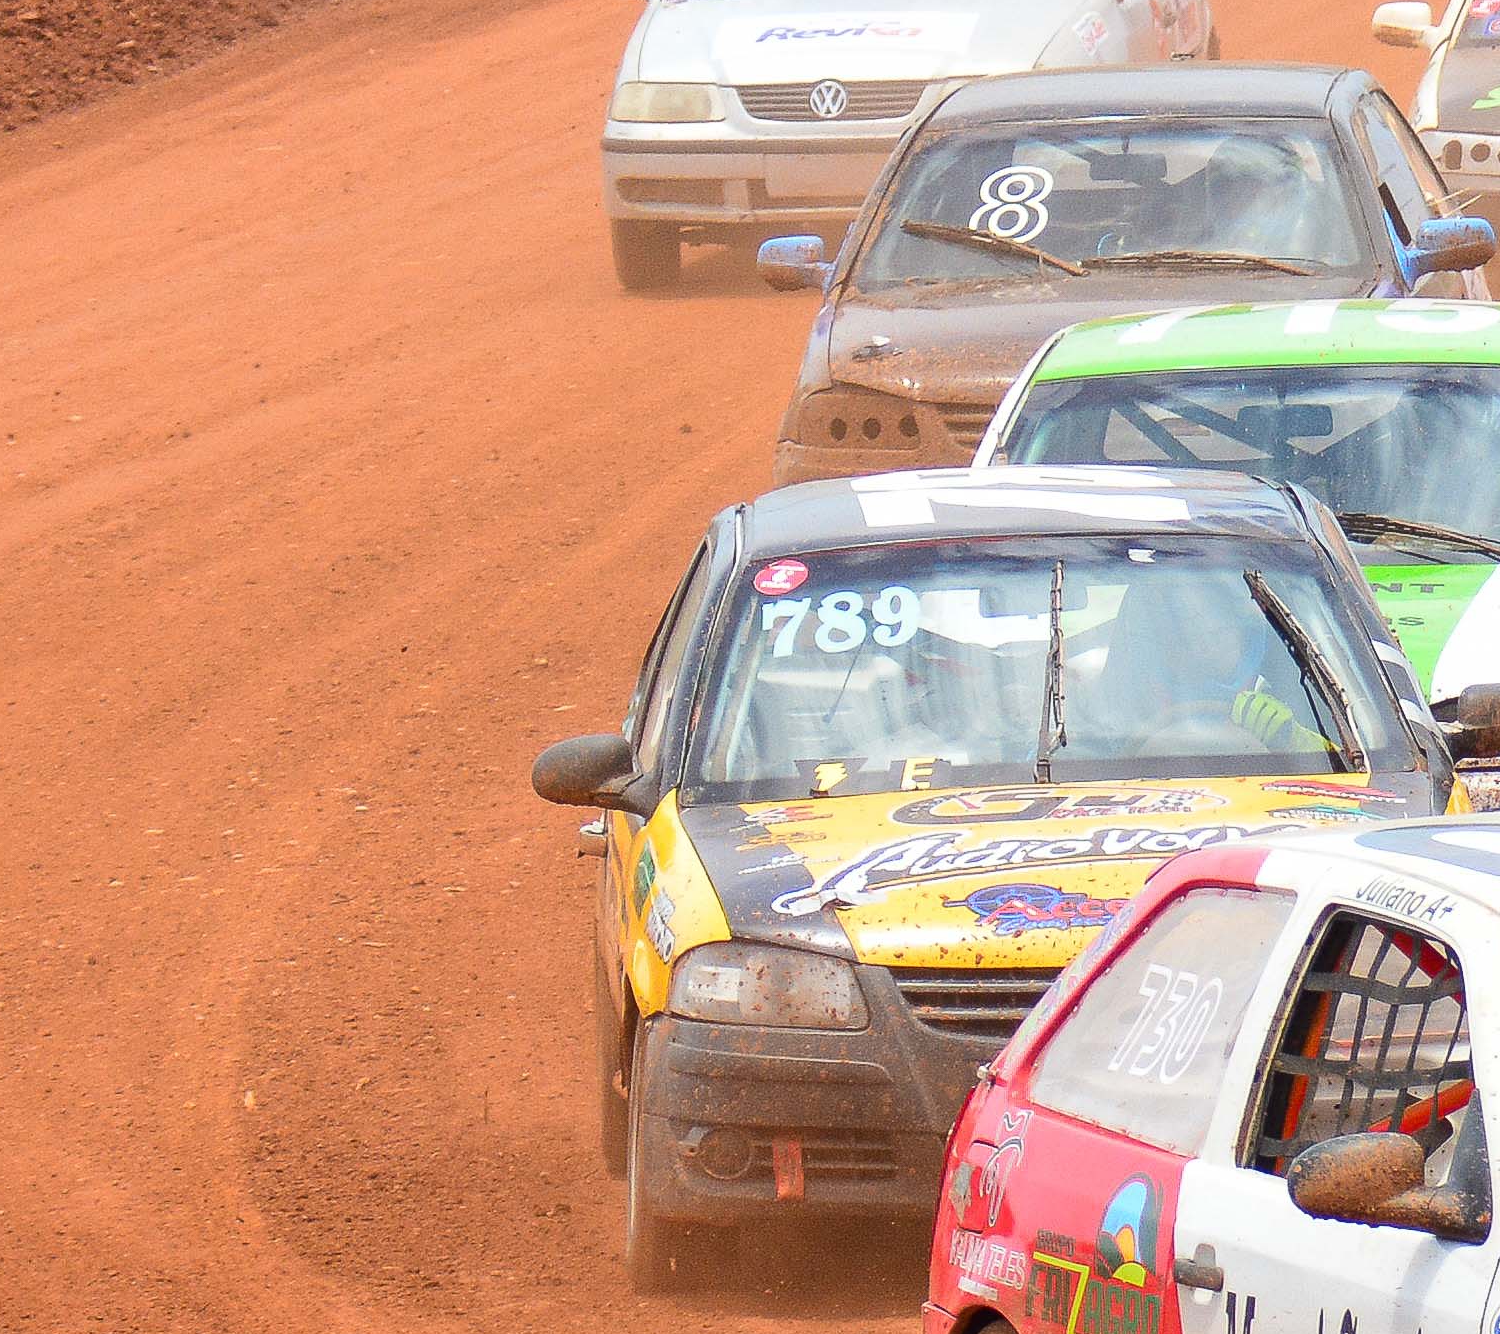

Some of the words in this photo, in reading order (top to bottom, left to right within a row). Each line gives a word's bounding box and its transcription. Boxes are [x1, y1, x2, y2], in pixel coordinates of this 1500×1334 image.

[967, 164, 1054, 244] 8
[761, 584, 923, 658] 789
[1106, 960, 1225, 1087] 730
